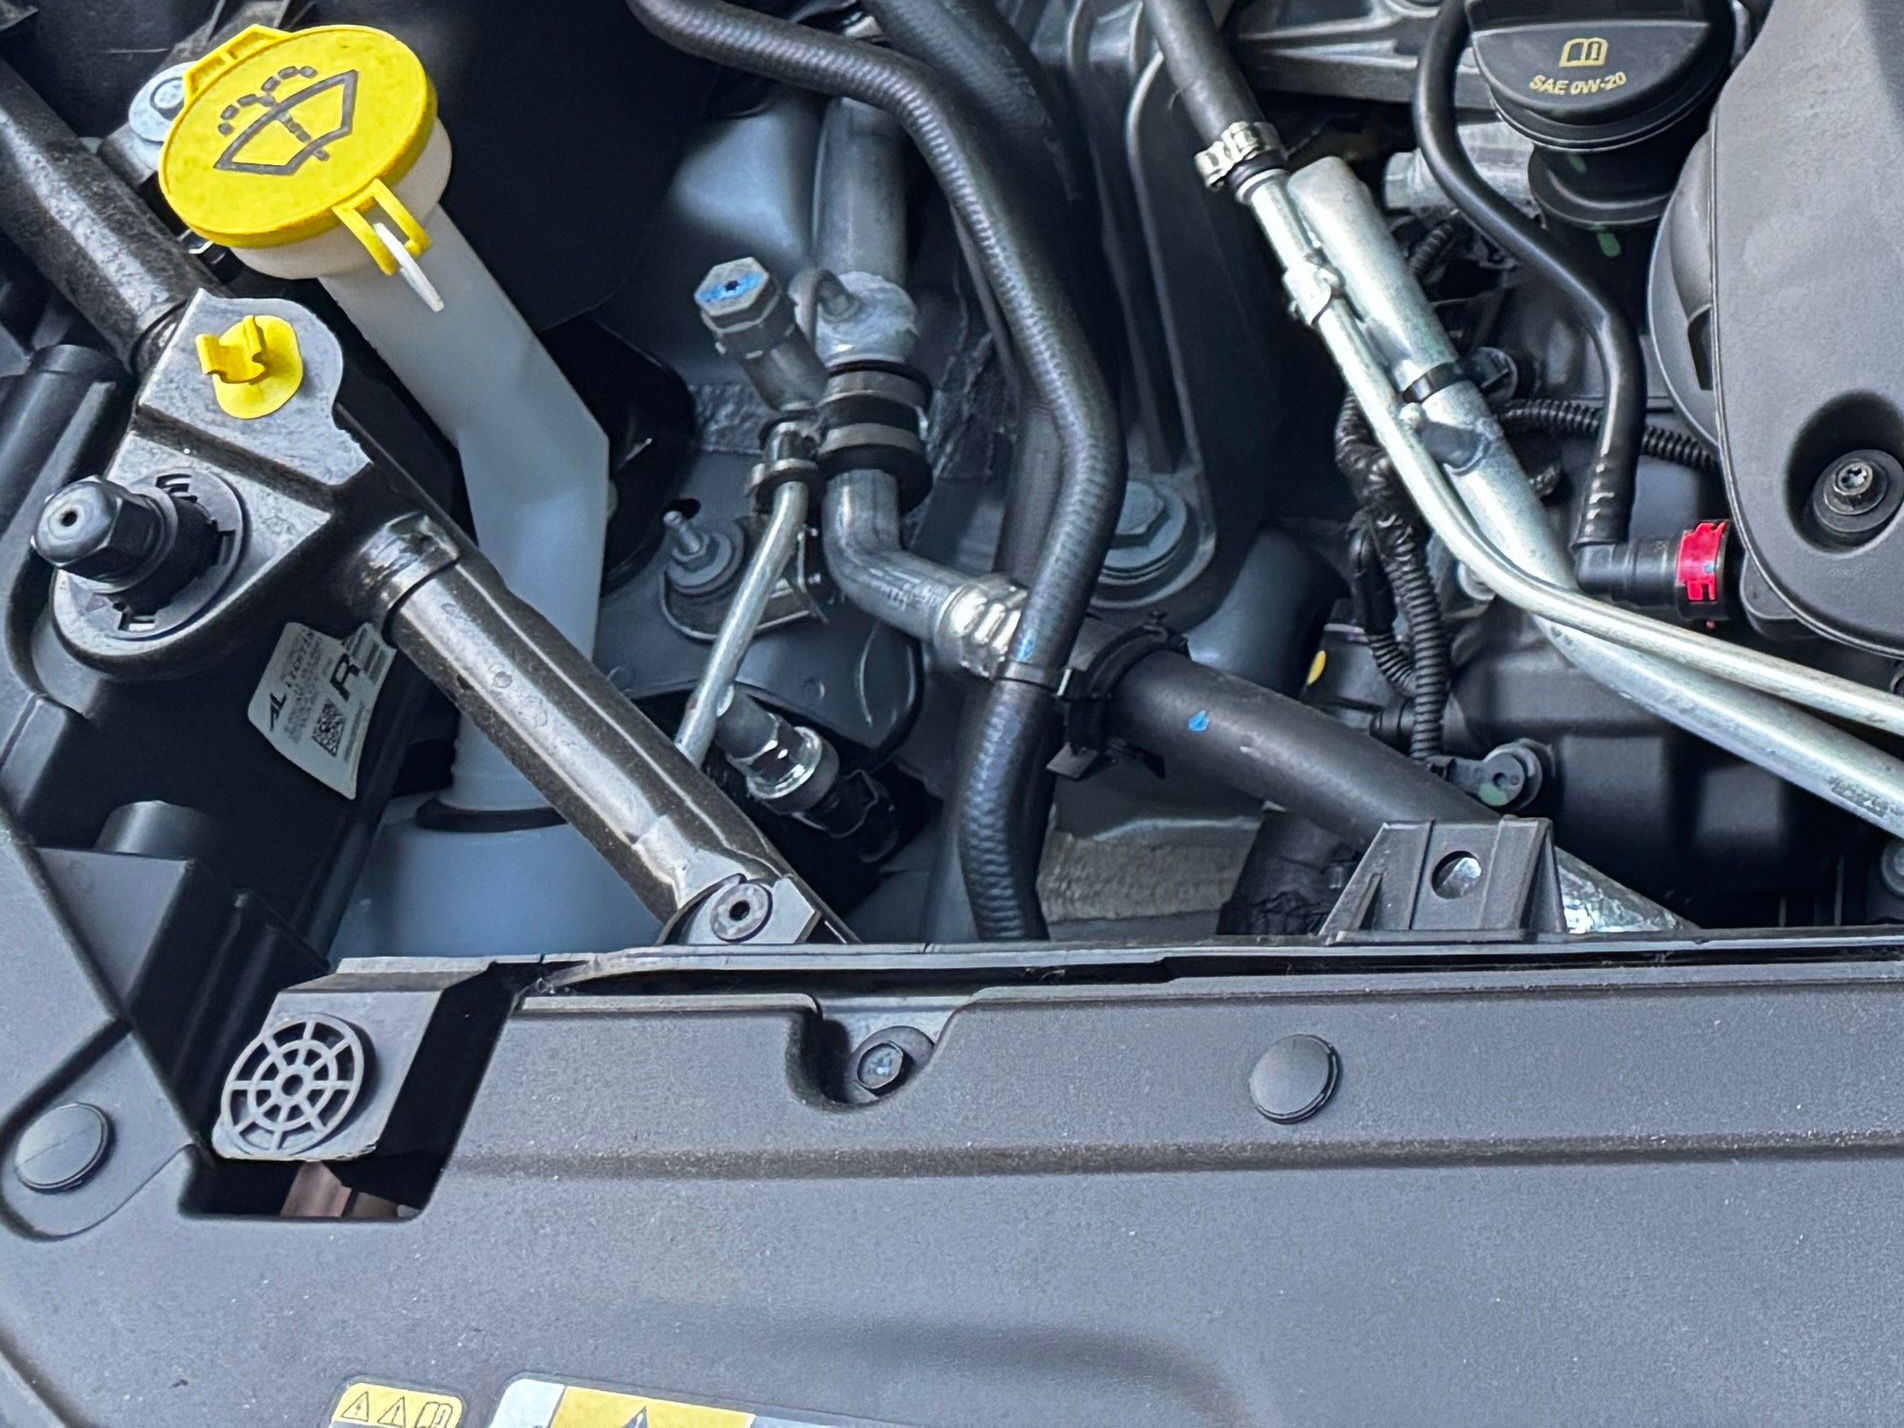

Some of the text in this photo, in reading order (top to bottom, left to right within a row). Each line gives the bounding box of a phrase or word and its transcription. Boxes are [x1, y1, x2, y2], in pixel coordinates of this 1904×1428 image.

[1529, 71, 1627, 96] SAE 0W-20
[329, 652, 361, 702] R
